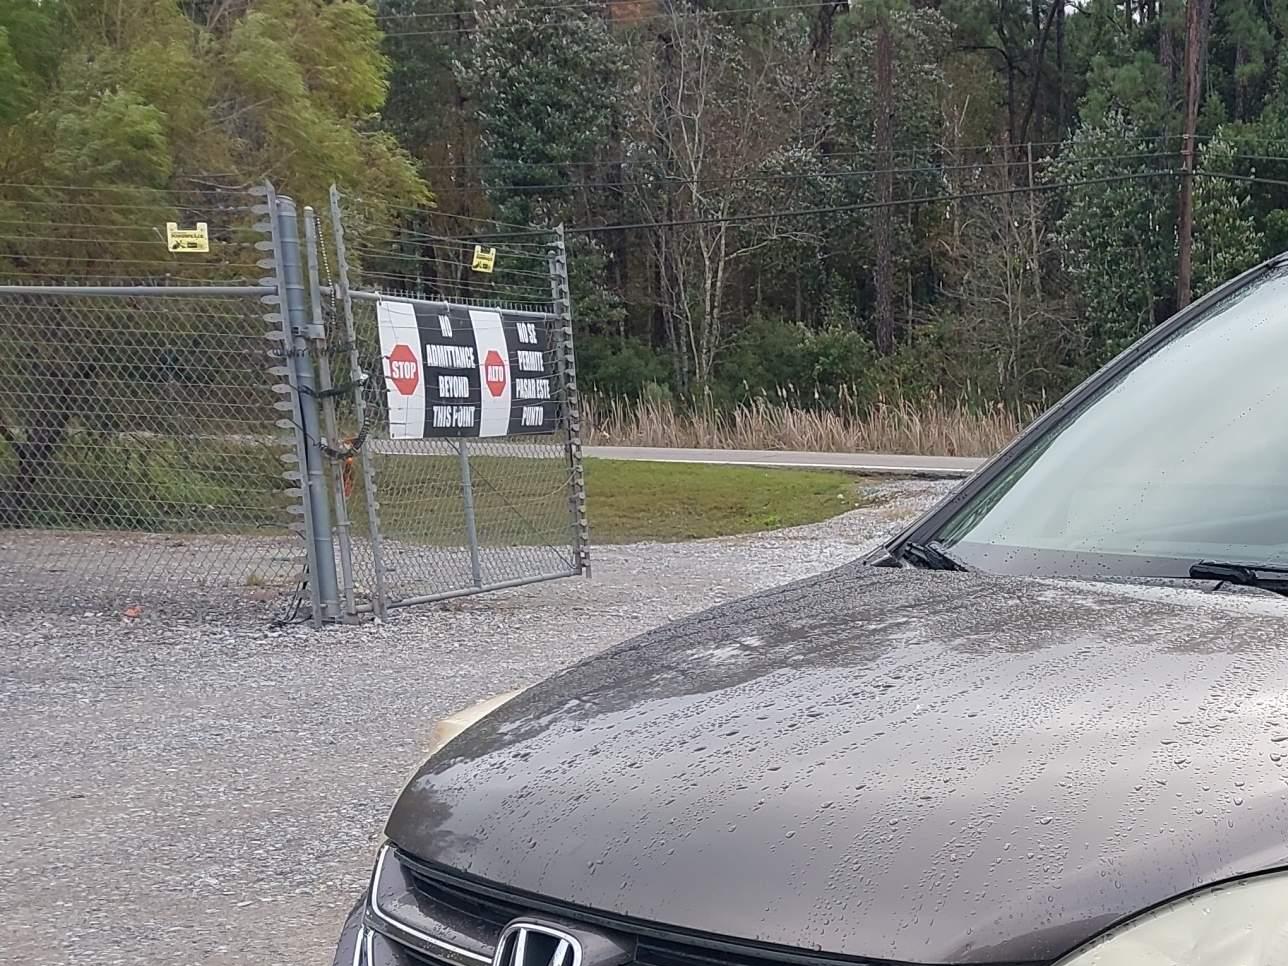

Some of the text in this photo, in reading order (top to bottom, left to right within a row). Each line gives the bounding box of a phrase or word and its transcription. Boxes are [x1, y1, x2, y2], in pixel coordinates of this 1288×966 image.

[438, 315, 453, 338] NO
[516, 322, 538, 344] NO SE
[425, 344, 476, 369] ADMITTANCE
[517, 350, 545, 372] PERMITE
[391, 361, 417, 379] STOP
[487, 365, 504, 382] ALTO
[438, 375, 470, 398] BEYOND
[515, 378, 551, 399] PASAR ESTE
[433, 405, 475, 428] THIS POINT
[521, 405, 544, 426] PUNTO
